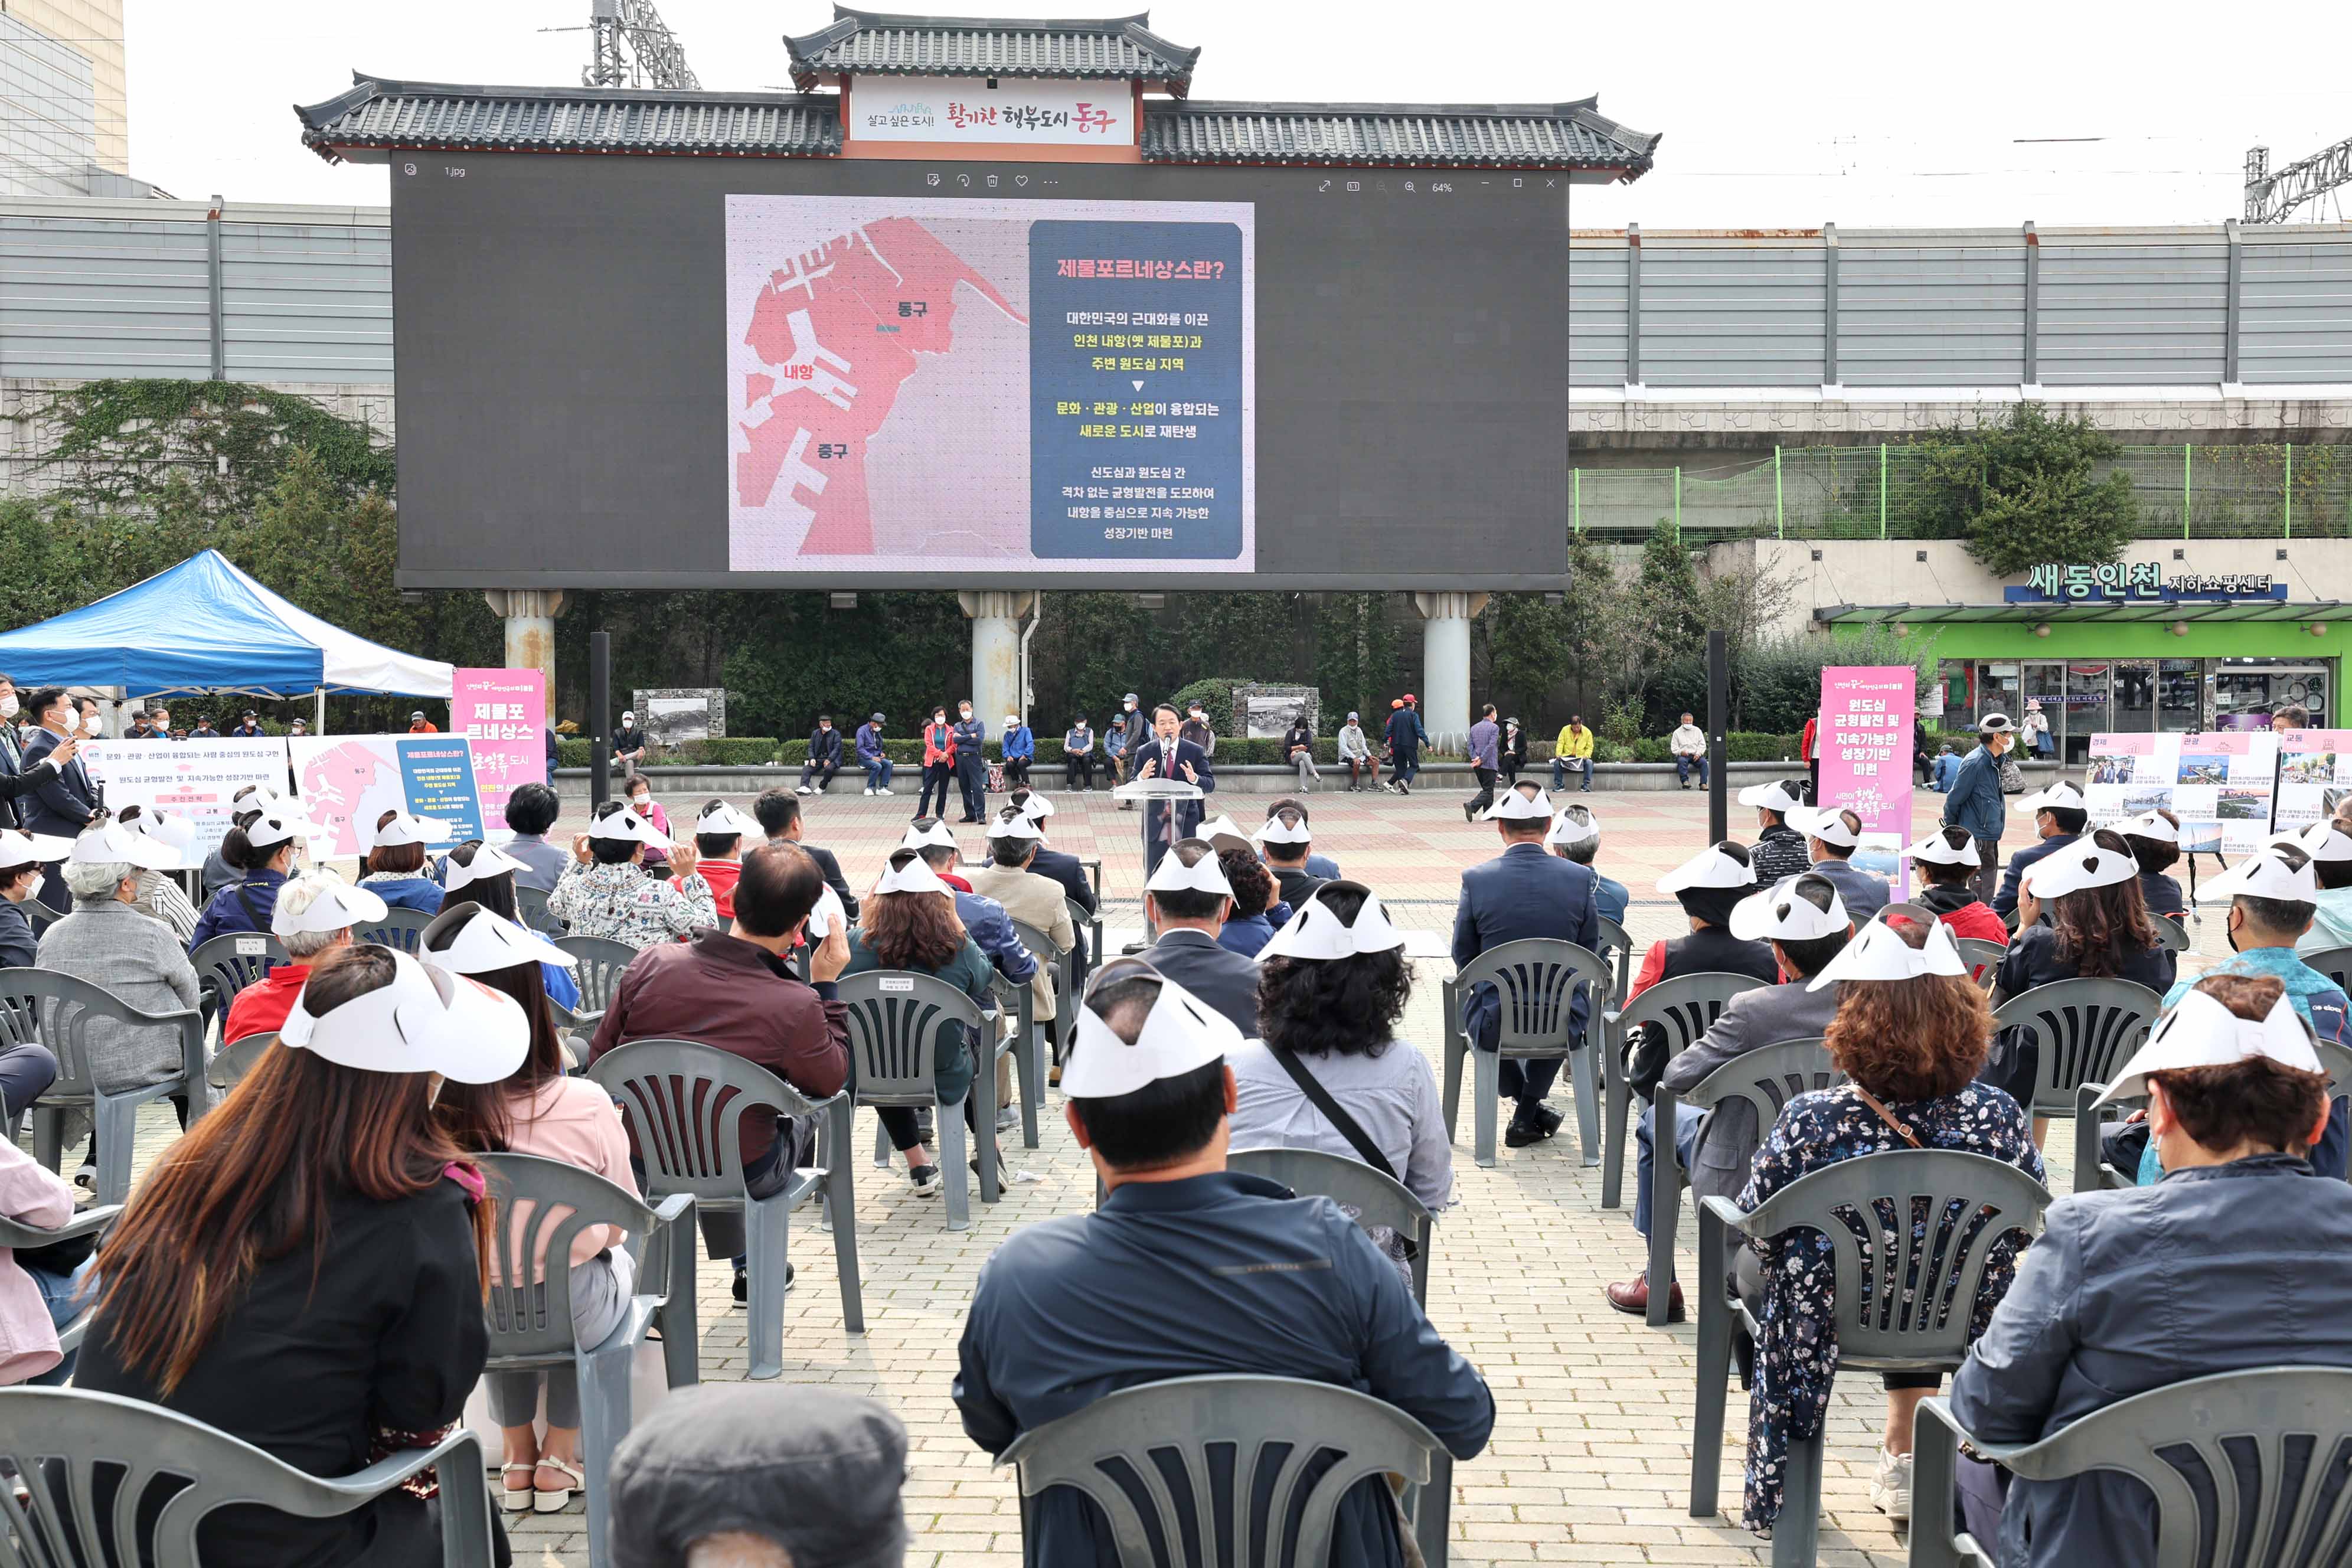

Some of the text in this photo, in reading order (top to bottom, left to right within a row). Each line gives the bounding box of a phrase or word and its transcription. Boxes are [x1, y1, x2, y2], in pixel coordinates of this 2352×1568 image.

[868, 115, 935, 127] 살고 싶은 도시!
[947, 103, 1116, 133] 활기찬 행복도시 동구
[445, 166, 465, 177] 1.jpg
[1432, 183, 1452, 192] 64%
[1057, 259, 1226, 279] 제물포르네상스란?
[898, 301, 927, 317] 동구
[1066, 312, 1208, 326] 대한민국의 근대화를 이끈
[1074, 335, 1203, 348] 인천 내항(옛 제물포)과
[1092, 358, 1184, 371] 주변 원도심 지역
[784, 364, 814, 380] 내항
[1057, 401, 1219, 416] 문화 관광 산업이 융합되는
[1079, 424, 1197, 439] 새로운 도시로 재탄생
[818, 444, 848, 459] 중구
[1091, 466, 1185, 479] 신도심과 원도심 간
[1061, 487, 1214, 499] 격차 없는 균형발전을 도모하여
[1067, 508, 1209, 519] 내항을 중심으로 지속 가능한
[1104, 528, 1173, 539] 성장기반 마련
[2027, 563, 2272, 598] 새동인천 지하쇼핑센터
[474, 703, 525, 720] 제물포
[1848, 699, 1886, 713] 원도심
[1834, 714, 1899, 728] 균형발전 및
[467, 724, 534, 740] 르네상스
[1835, 732, 1898, 746] 지속가능한
[1841, 747, 1891, 761] 성장기반
[472, 752, 529, 779] 초일류 도시
[1853, 762, 1877, 776] 마련
[1835, 792, 1854, 800] 시민이
